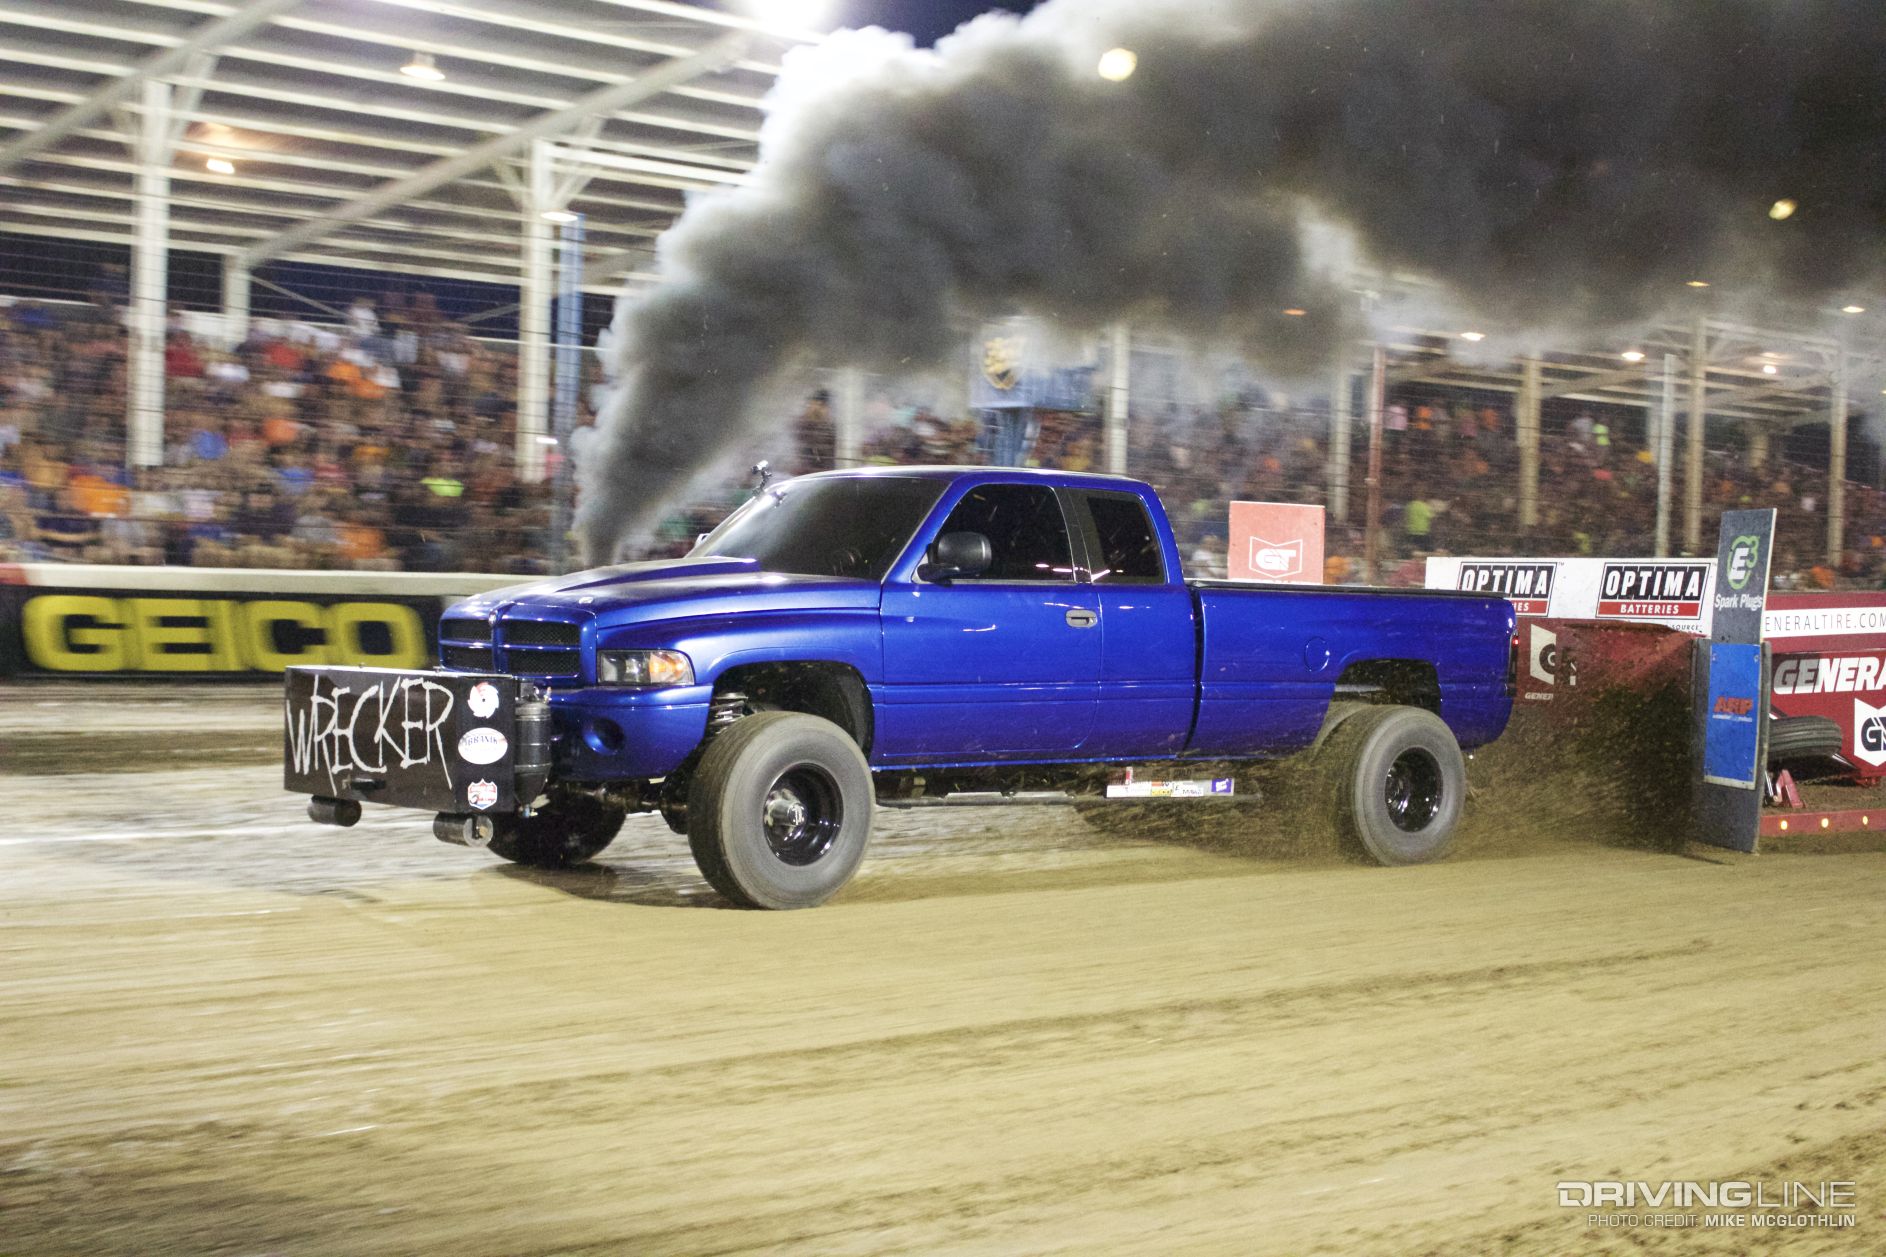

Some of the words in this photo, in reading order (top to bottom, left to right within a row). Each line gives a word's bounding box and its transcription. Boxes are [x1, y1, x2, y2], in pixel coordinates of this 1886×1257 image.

[1461, 569, 1548, 595] OPTIMA
[1605, 570, 1700, 596] OPTIMA
[1620, 604, 1679, 614] BATTERIES
[1714, 593, 1739, 611] Spark
[1739, 593, 1763, 612] Plugs
[22, 594, 428, 671] GEICO
[1764, 612, 1886, 632] ENERALTIRE.COM
[286, 673, 454, 797] WRECKER
